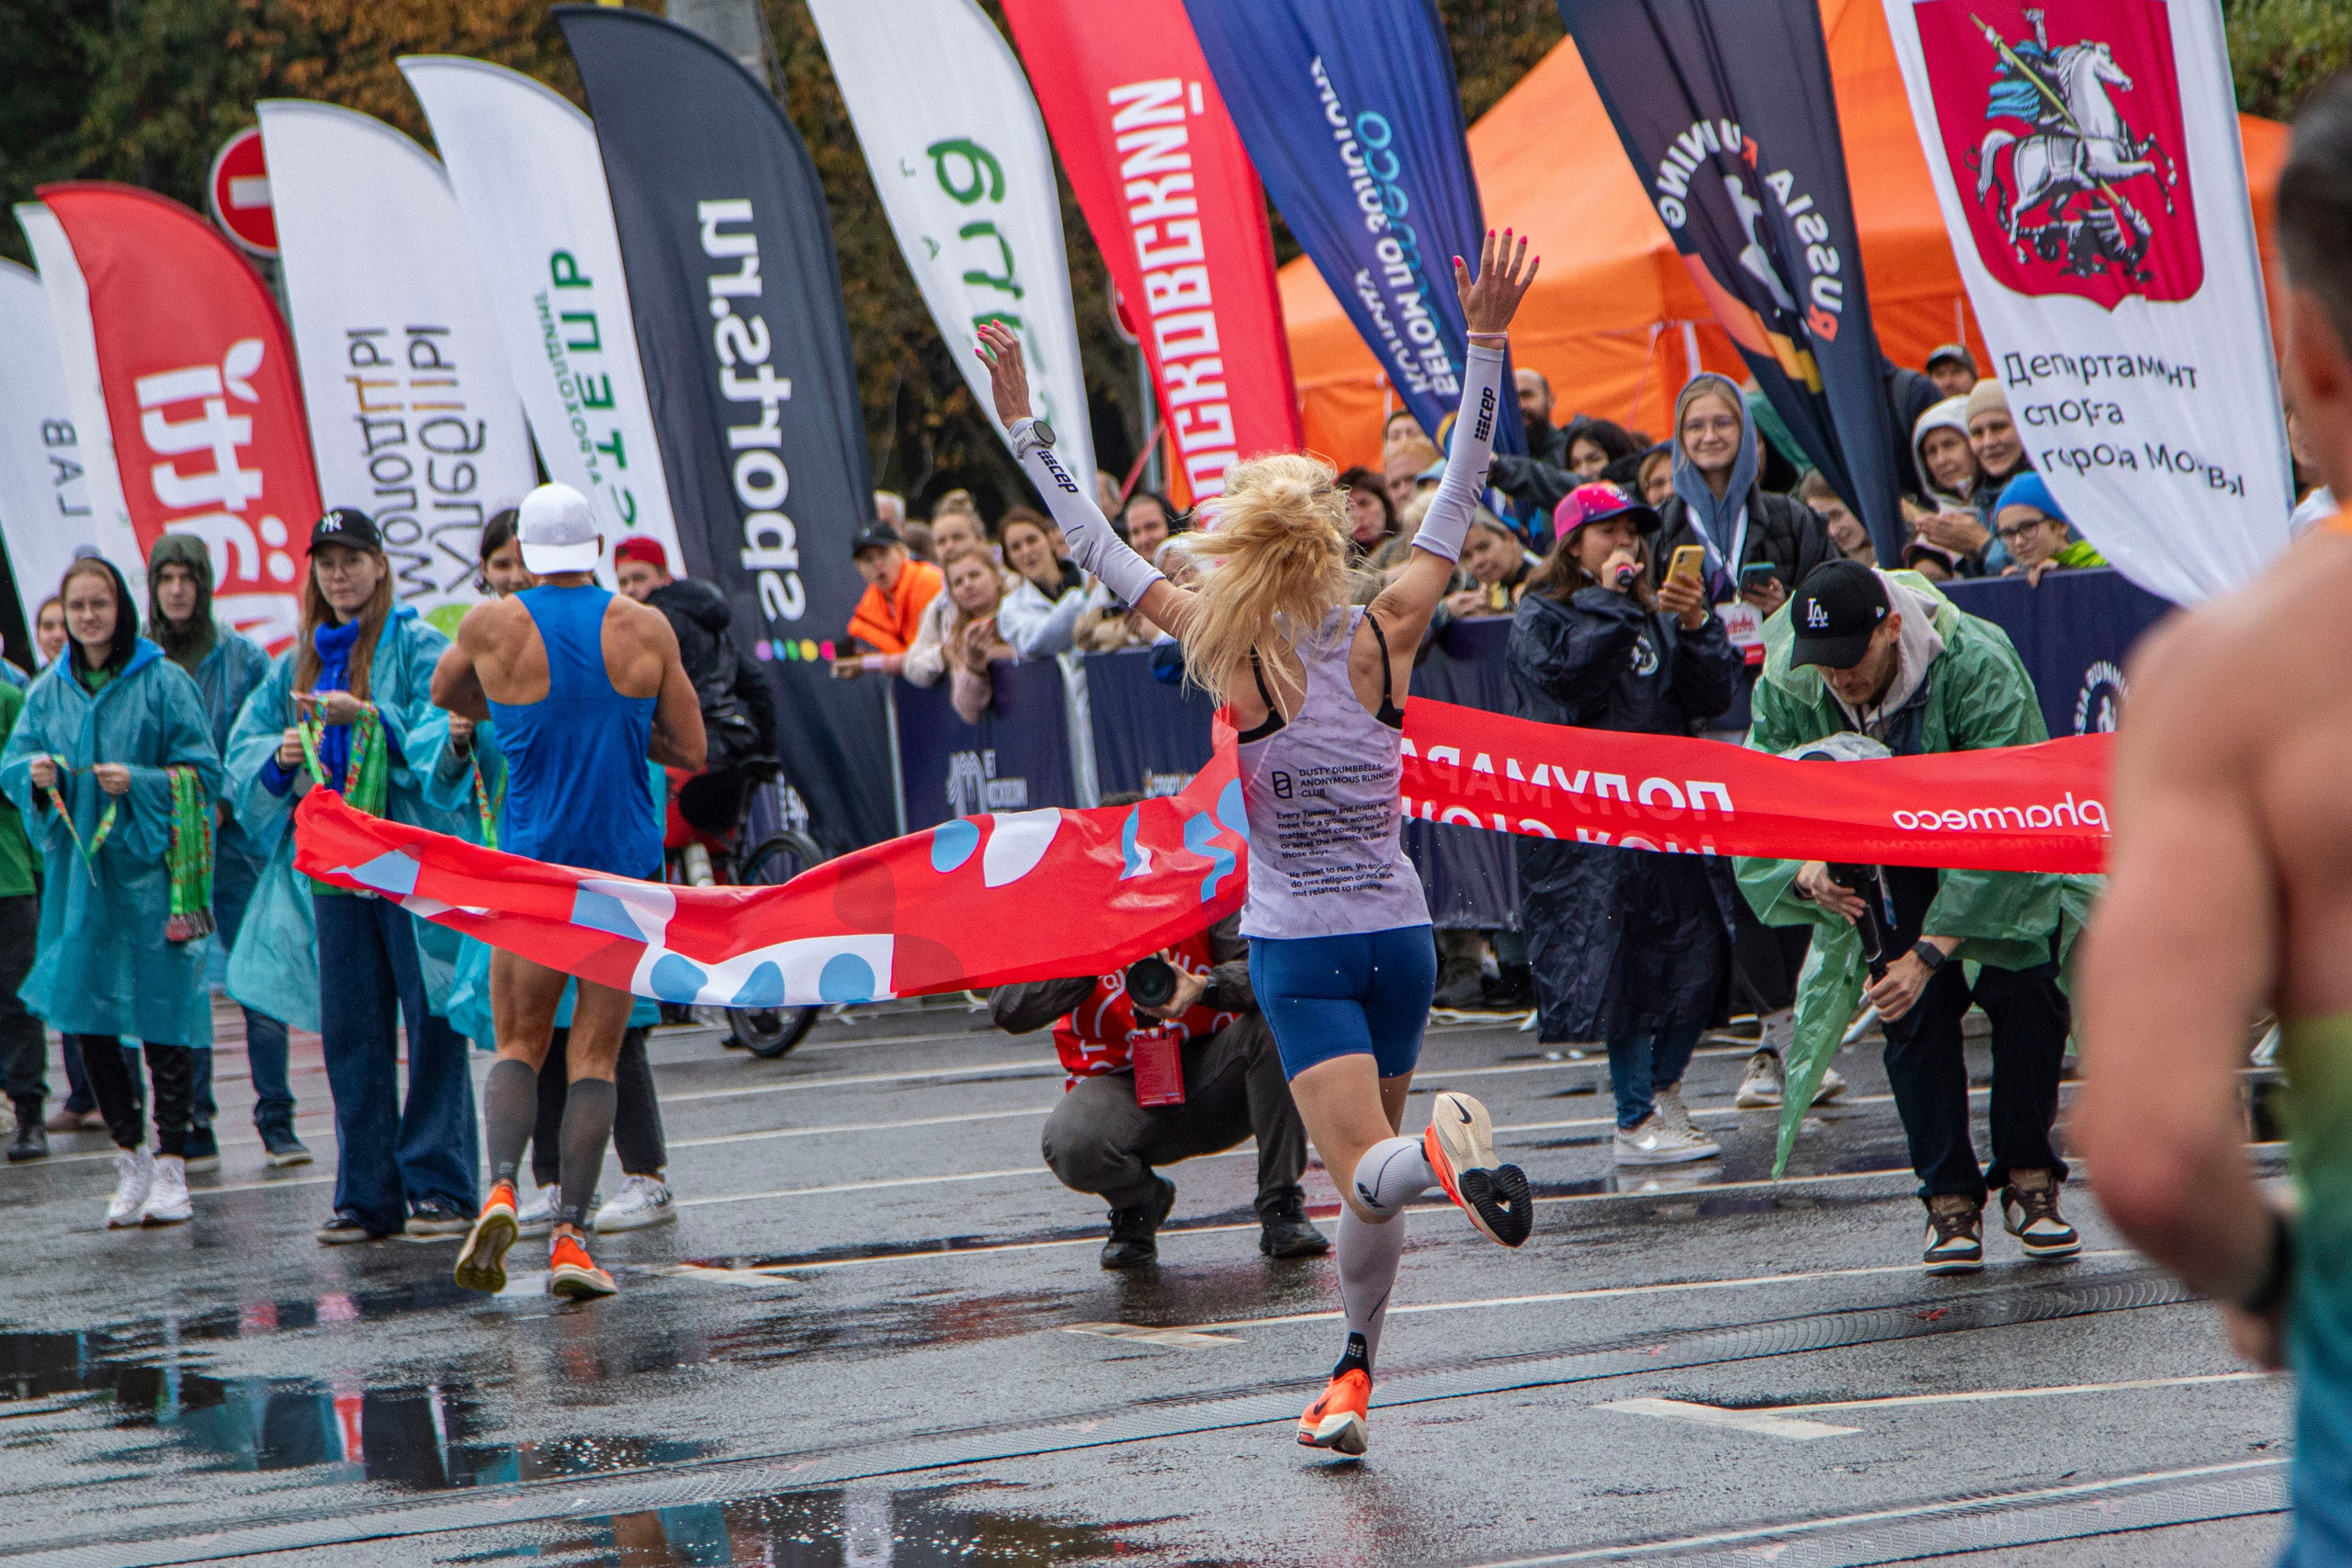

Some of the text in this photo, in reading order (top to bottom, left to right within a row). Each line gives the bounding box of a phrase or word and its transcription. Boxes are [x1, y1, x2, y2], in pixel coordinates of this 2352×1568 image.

[2143, 441, 2246, 498] Мовы
[1806, 597, 1829, 628] LA
[1299, 767, 1330, 777] DUSTY
[1301, 771, 1395, 787] ANONYMOUS RUNNING
[1301, 789, 1326, 798] CLUB
[1276, 812, 1300, 820] Every
[1303, 808, 1337, 818] Tuesday
[1339, 805, 1353, 814] and
[1355, 802, 1377, 812] Friday
[1303, 820, 1317, 829] for
[1324, 818, 1348, 826] group
[1279, 832, 1309, 840] matter
[1310, 829, 1331, 838] what
[1292, 840, 1315, 850] what
[1316, 838, 1330, 846] the
[1282, 852, 1306, 860] those
[1303, 869, 1325, 878] meet
[1321, 876, 1354, 886] religion
[1292, 889, 1307, 898] not
[1309, 886, 1340, 897] related
[1342, 885, 1352, 893] to
